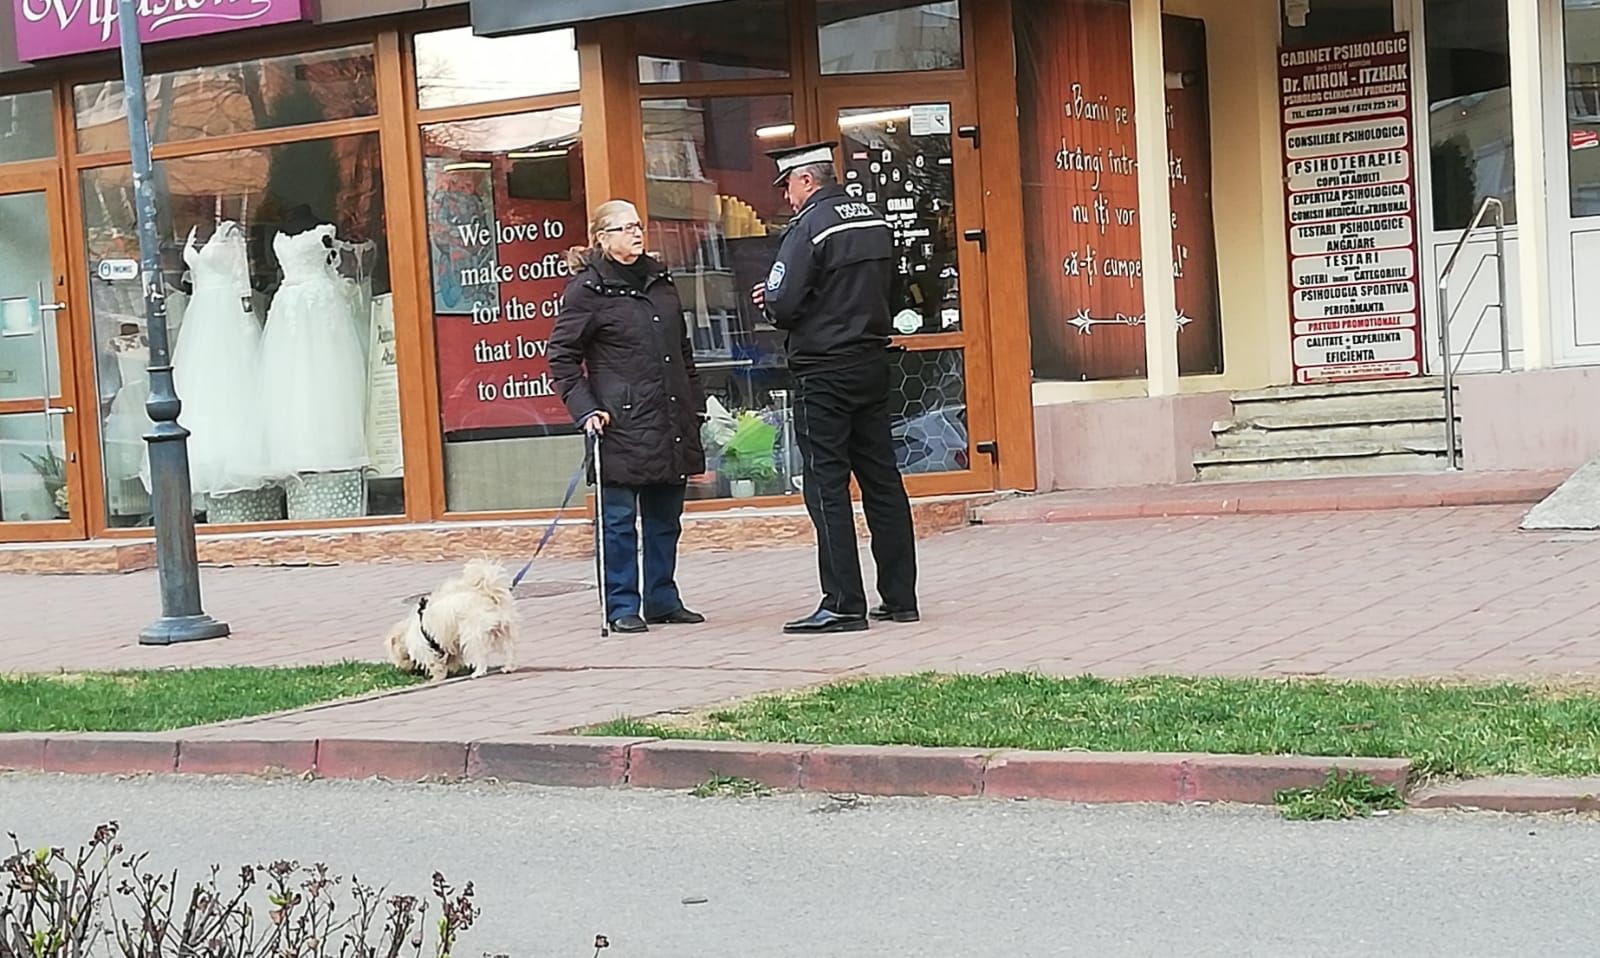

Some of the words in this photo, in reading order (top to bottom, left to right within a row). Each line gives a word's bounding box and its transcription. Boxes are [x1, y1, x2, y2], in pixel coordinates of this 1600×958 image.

[1281, 48, 1332, 67] CABINET
[1333, 38, 1408, 61] PSIHOLOGIC
[1282, 78, 1301, 94] Dr.
[1303, 71, 1348, 92] MIRON
[1359, 63, 1408, 84] ITZHAK
[1114, 106, 1128, 135] pe
[1288, 132, 1341, 149] CONSILIERE
[1342, 125, 1406, 143] PSIHOLOGICA
[1056, 136, 1104, 191] strângi
[1294, 151, 1402, 175] PSIHOTERAPIE
[1351, 172, 1380, 185] ADULTI
[1293, 190, 1341, 206] EXPERTIZA
[1342, 184, 1406, 200] PSIHOLOGICA
[1072, 204, 1090, 224] nu
[1093, 192, 1110, 235] îți
[1115, 207, 1136, 226] vor
[457, 222, 492, 247] We
[495, 220, 539, 244] love
[543, 218, 564, 239] to
[1298, 225, 1337, 239] TESTARI
[1340, 217, 1404, 234] PSIHOLOGICE
[1326, 237, 1376, 252] ANGAJARE
[1063, 243, 1099, 287] să-ți
[1325, 252, 1379, 267] TESTARI
[460, 260, 515, 287] make
[1354, 267, 1407, 281] CATEGORIILE
[1301, 286, 1358, 302] PSIHOLOGIA
[1360, 282, 1409, 297] SPORTIVA
[471, 300, 501, 325] for
[505, 296, 537, 321] the
[1324, 302, 1385, 316] PERFORMANTA
[1308, 320, 1341, 332] PRETURI
[1342, 315, 1401, 329] PROMOTIONALE
[474, 338, 513, 363] that
[516, 335, 548, 359] lov
[1306, 335, 1343, 348] CALITATE
[1352, 332, 1402, 345] EXPERIENTA
[1326, 349, 1375, 363] EFICIENTA
[477, 381, 497, 401] to
[502, 372, 556, 399] drink
